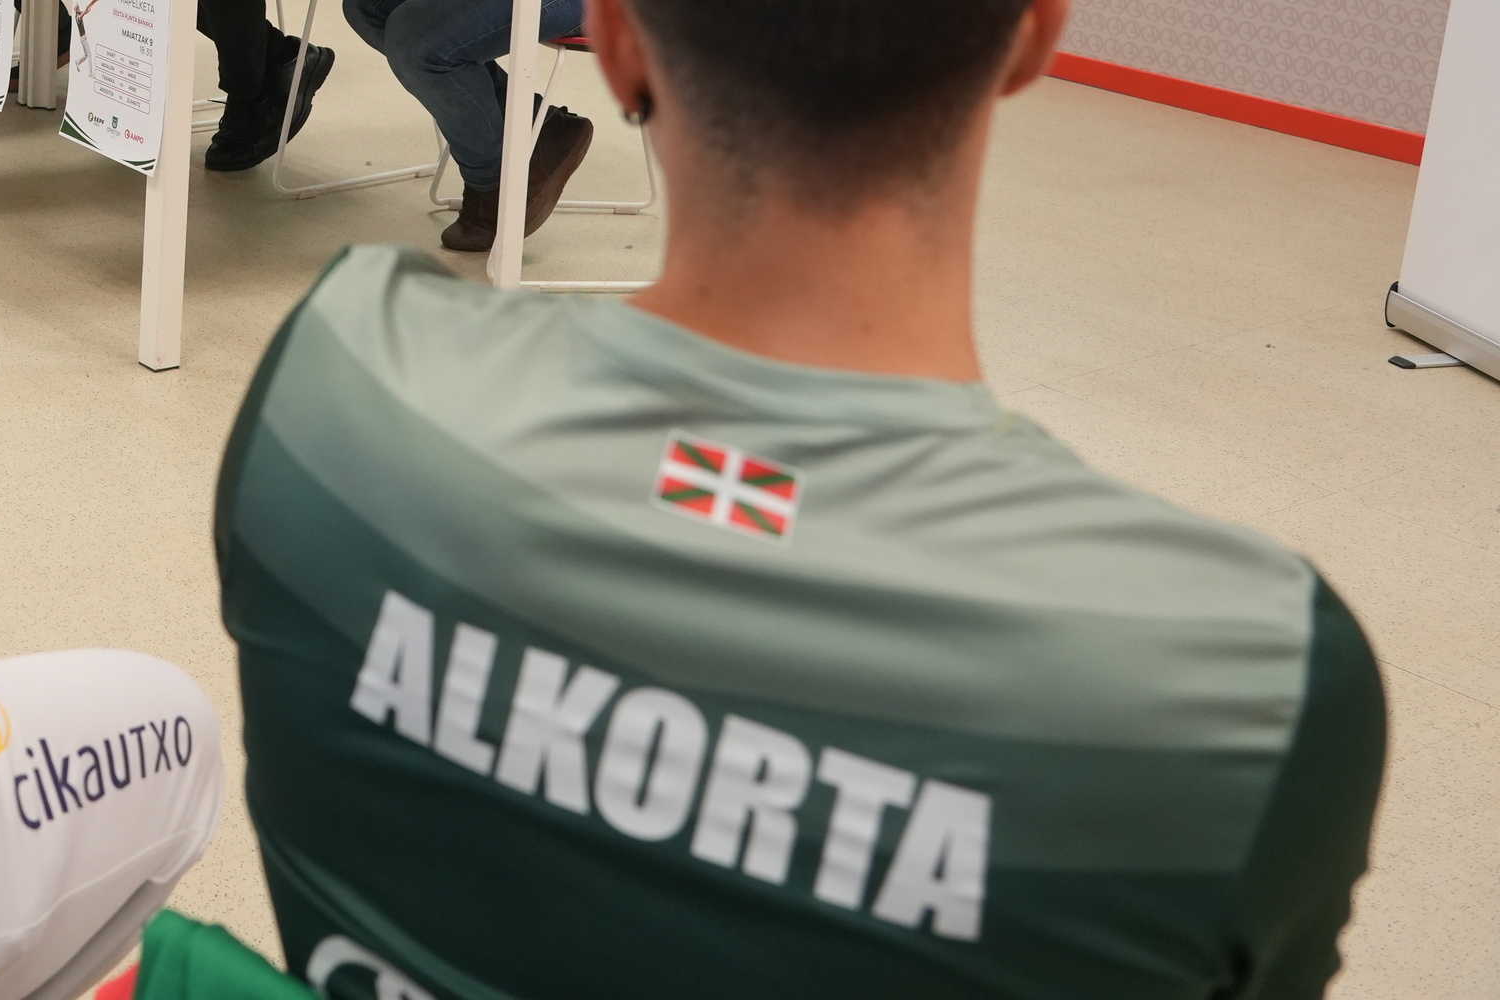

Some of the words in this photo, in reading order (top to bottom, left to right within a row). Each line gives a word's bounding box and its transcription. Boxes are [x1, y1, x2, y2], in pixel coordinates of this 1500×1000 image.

[112, 8, 125, 18] ZESTA
[124, 12, 138, 22] PUNTA
[137, 17, 154, 28] BANAKA
[121, 29, 148, 44] MAIATZAK
[148, 38, 153, 47] 9
[139, 45, 153, 57] 18:30
[93, 116, 105, 124] EEPF
[130, 132, 144, 144] AMPO
[350, 589, 992, 942] ALKORTA
